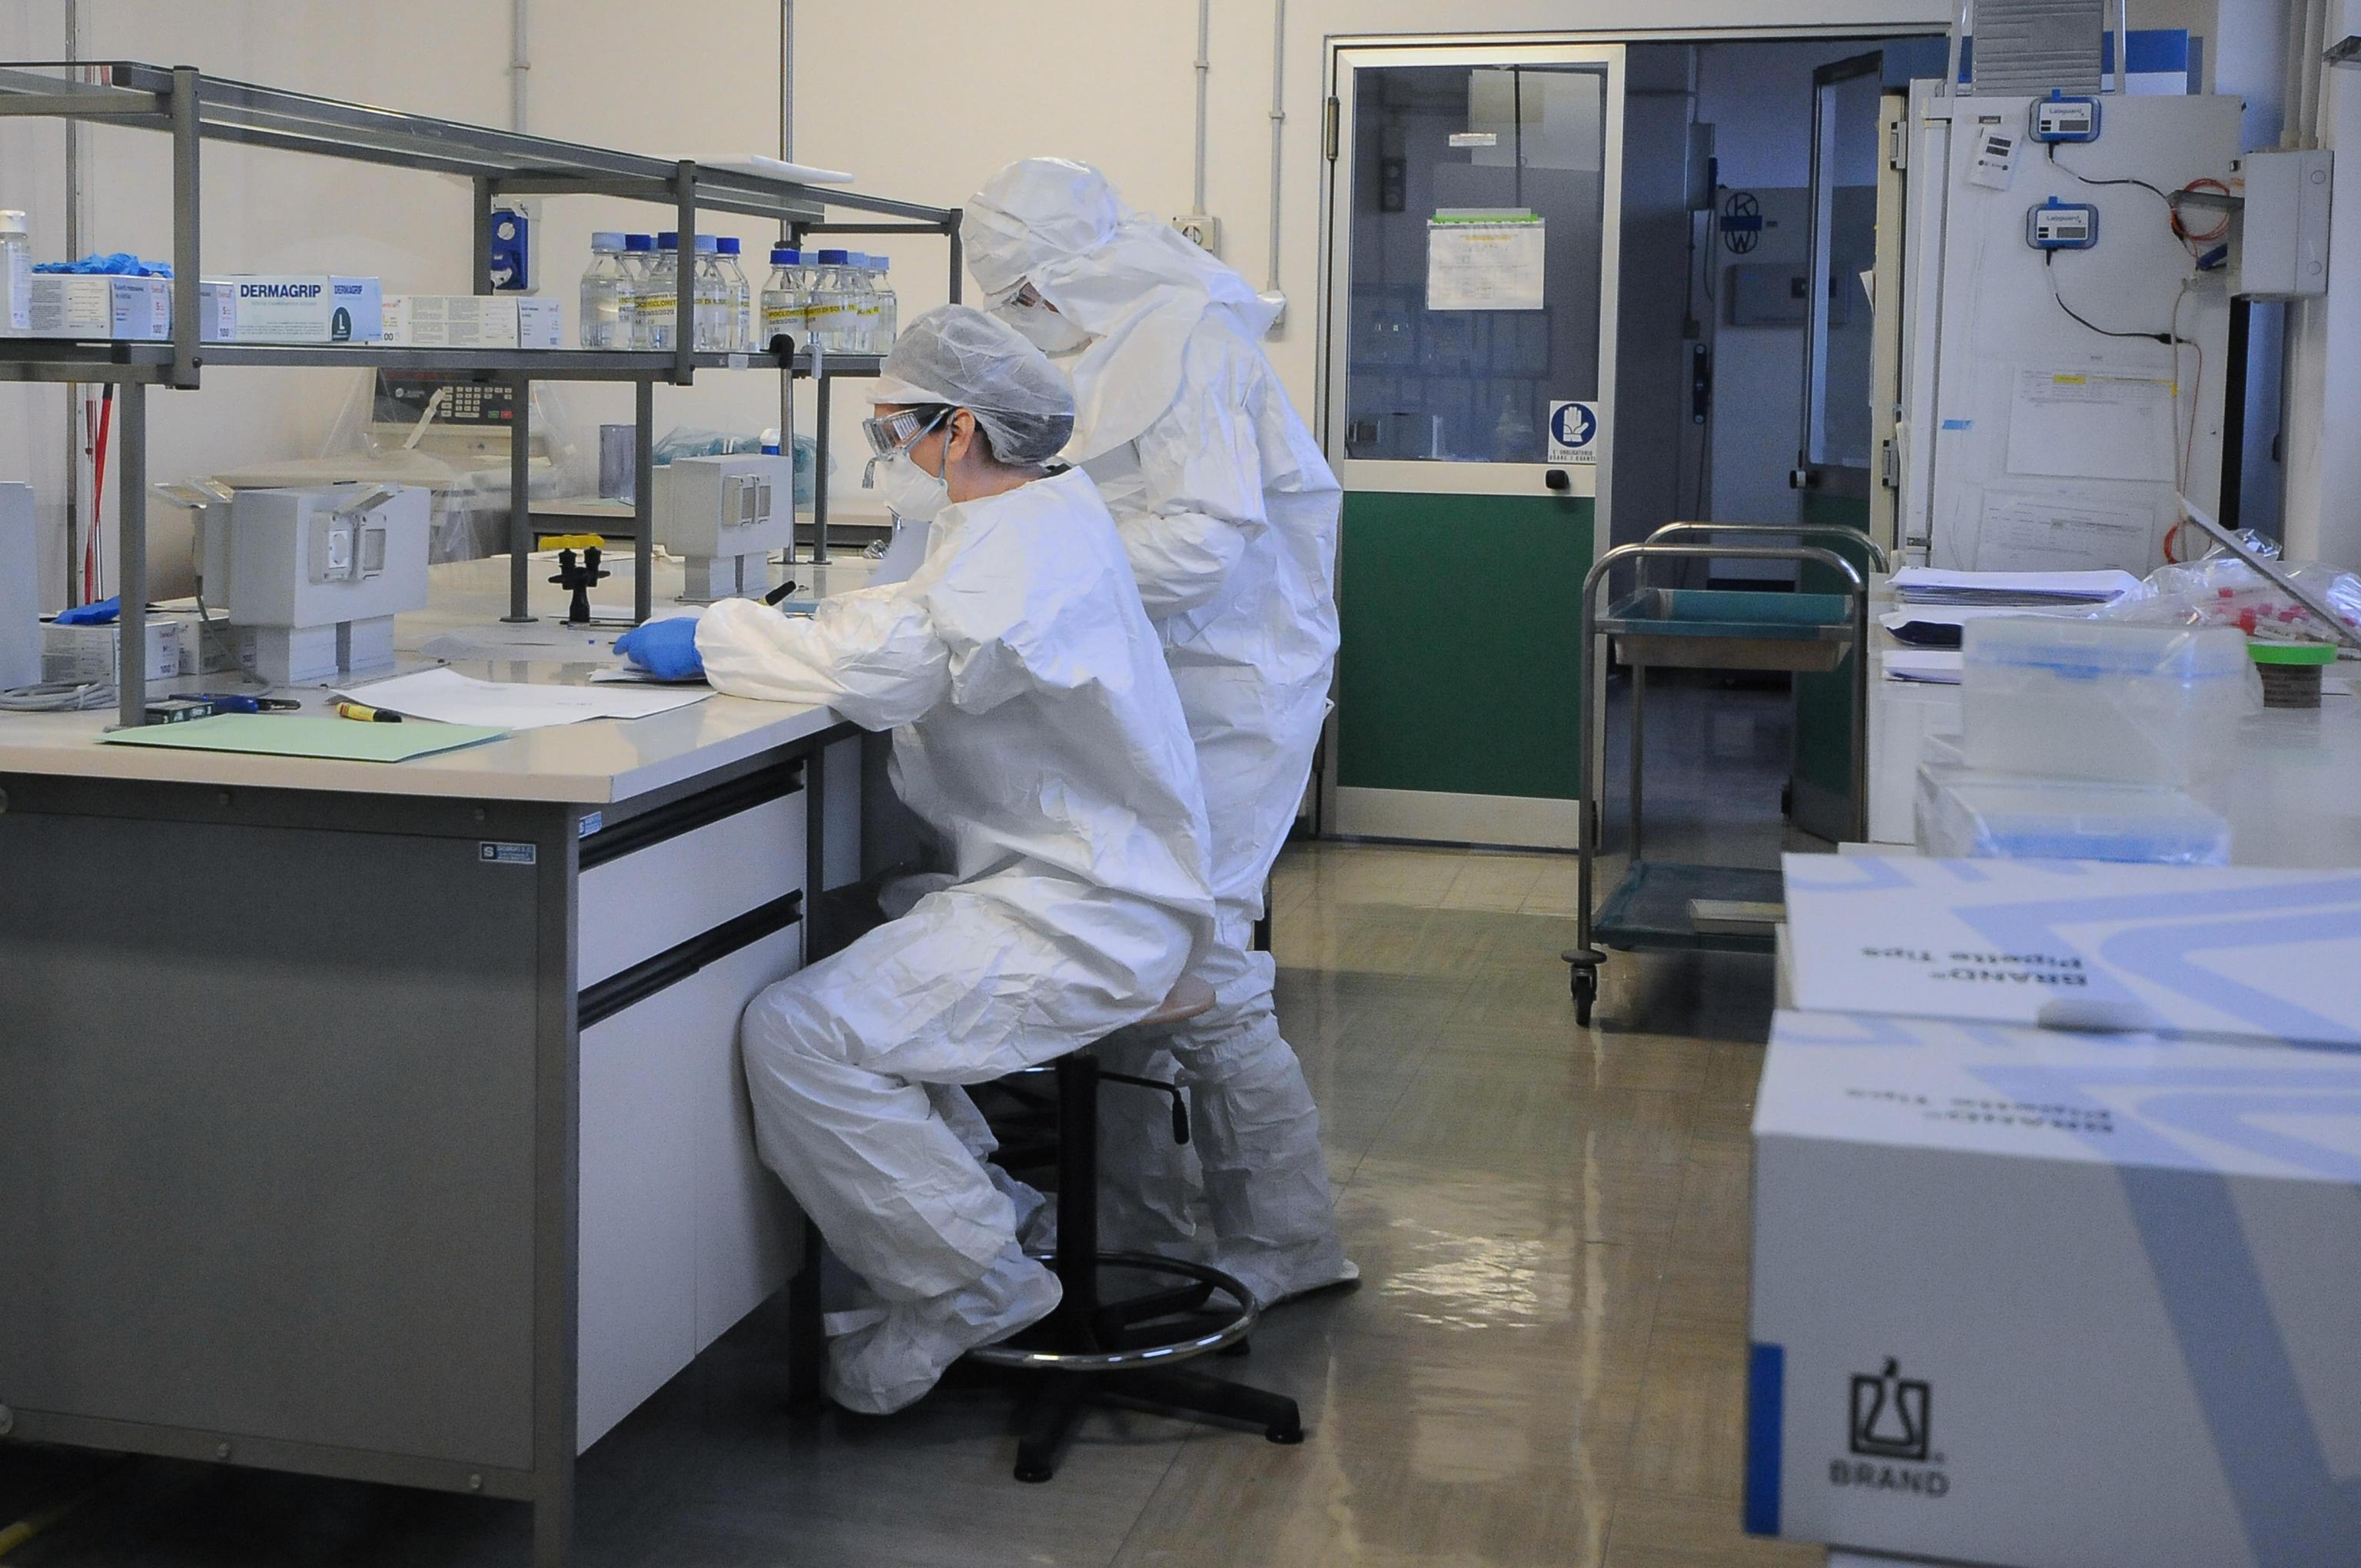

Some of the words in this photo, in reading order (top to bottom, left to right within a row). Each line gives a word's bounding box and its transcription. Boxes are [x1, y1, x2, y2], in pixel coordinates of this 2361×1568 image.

[240, 284, 321, 298] DERMAGRIP
[338, 314, 345, 330] L
[384, 333, 394, 341] 00
[483, 846, 494, 858] S
[1860, 947, 1931, 962] Tips
[1949, 952, 2083, 970] Pipette
[1828, 1459, 1952, 1498] BRAND
